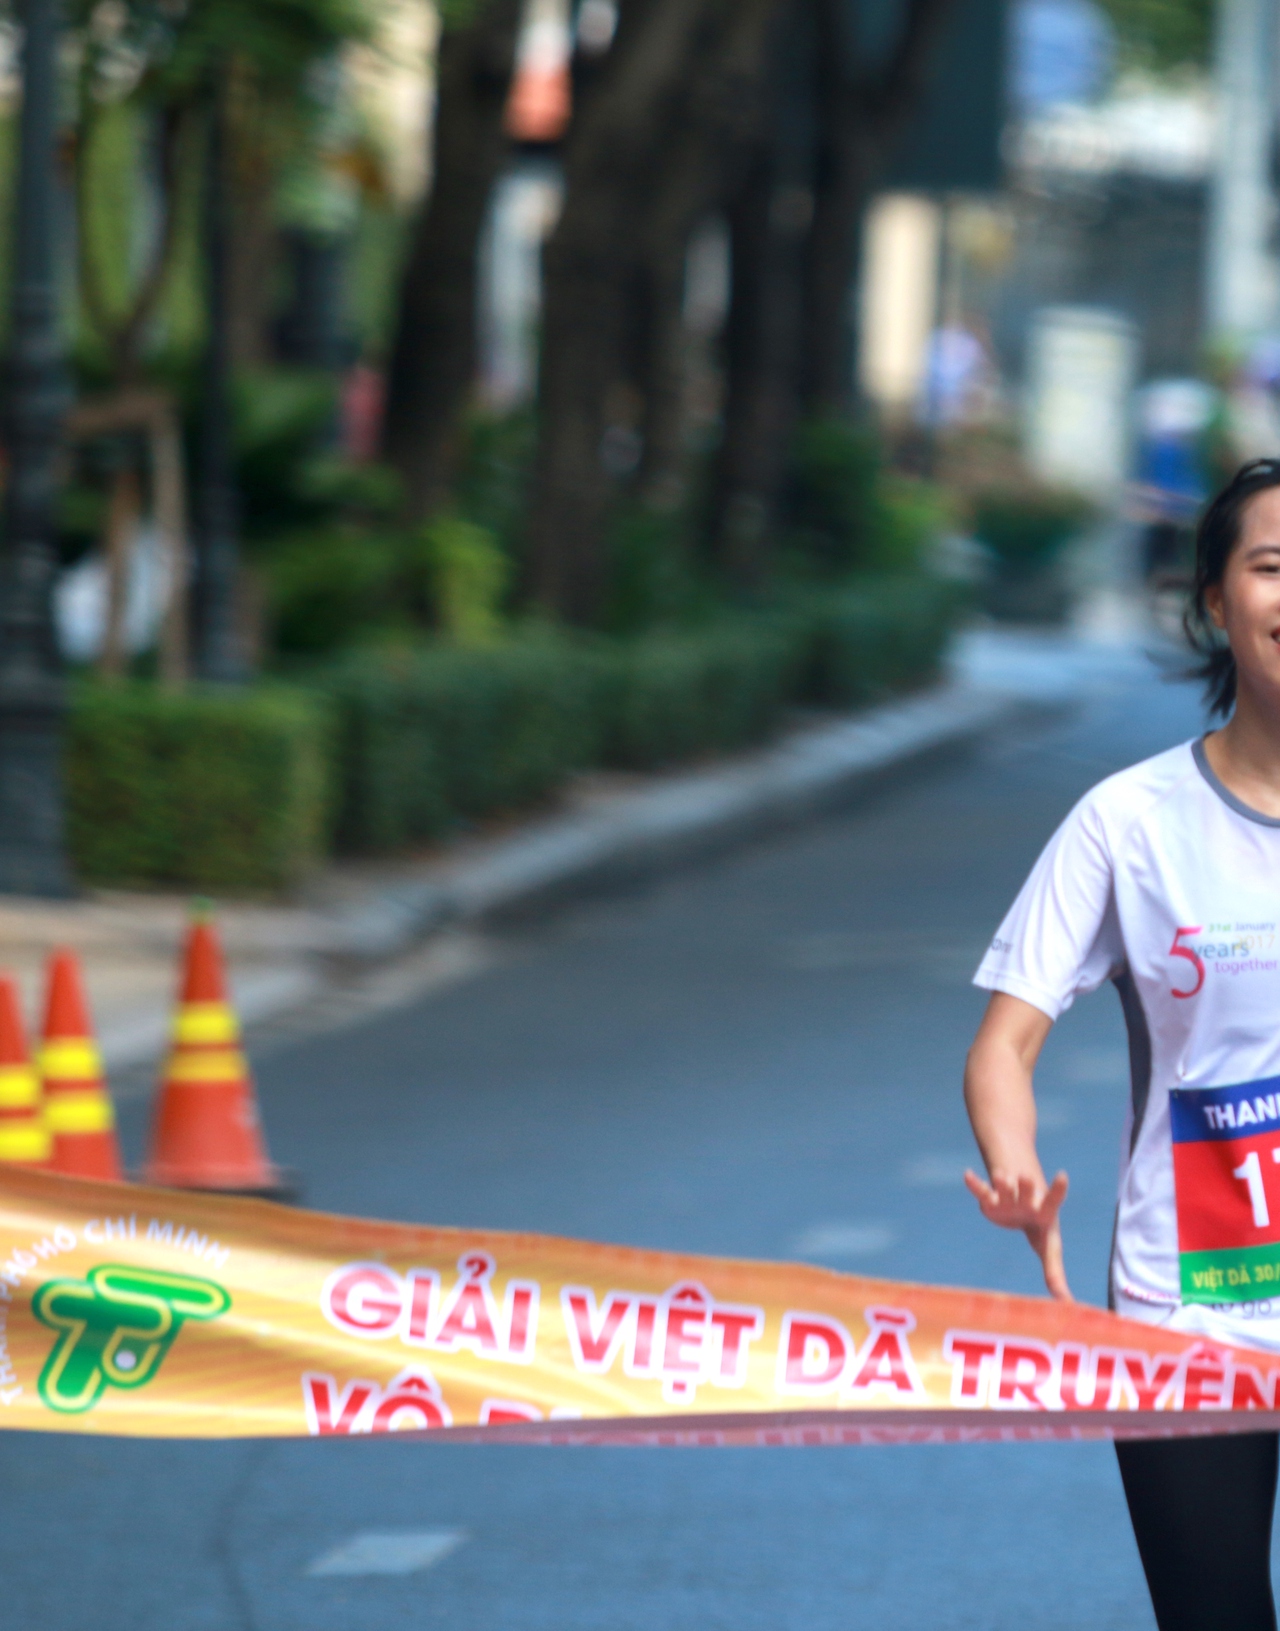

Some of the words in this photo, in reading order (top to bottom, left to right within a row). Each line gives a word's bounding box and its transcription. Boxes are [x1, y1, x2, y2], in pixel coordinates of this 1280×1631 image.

[1234, 921, 1276, 932] January
[1169, 926, 1206, 998] 5
[1191, 941, 1250, 961] years
[1214, 958, 1278, 975] together
[84, 1212, 137, 1244] CHÍ
[146, 1217, 231, 1270] MINH
[1192, 1266, 1224, 1292] VIỆT
[325, 1254, 535, 1358] GIẢI
[565, 1284, 760, 1396] VIỆT
[781, 1309, 918, 1395] DÃ
